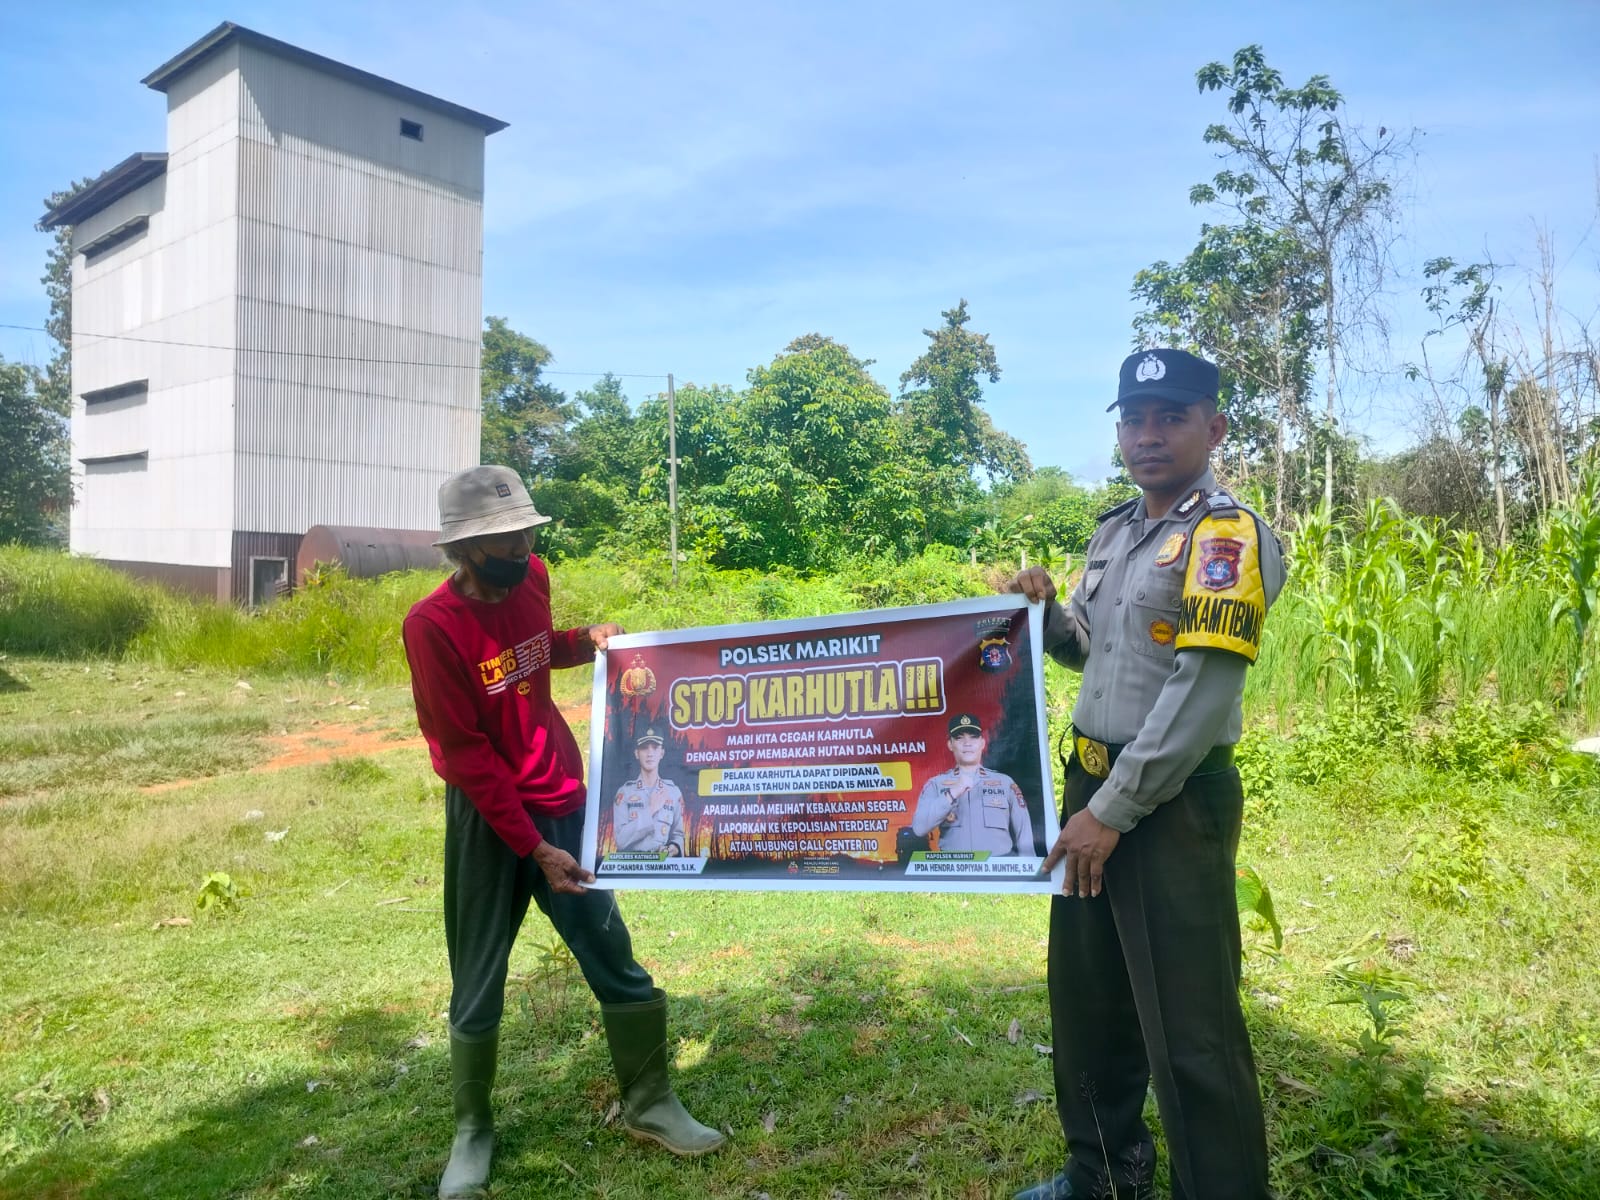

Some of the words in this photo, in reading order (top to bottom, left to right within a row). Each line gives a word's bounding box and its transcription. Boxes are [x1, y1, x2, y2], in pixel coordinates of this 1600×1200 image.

[721, 643, 792, 667] POLSEK
[796, 635, 881, 660] MARIKIT
[477, 648, 514, 672] TIMER
[673, 679, 743, 725] STOP
[749, 667, 899, 719] KARHUTLA
[904, 663, 940, 710] !!!
[726, 734, 753, 748] MARI
[755, 732, 778, 746] KITA
[780, 730, 816, 744] CEGAH
[817, 727, 874, 742] KARHUTLA
[686, 751, 728, 763] DENGAN
[728, 749, 755, 761] STOP
[756, 746, 816, 760] MEMBAKAR
[817, 744, 856, 757] HUTAN
[856, 743, 882, 755] DAN
[884, 741, 926, 755] LAHAN
[723, 769, 755, 780] PELAKU
[756, 768, 801, 780] KARHUTLA
[802, 767, 832, 779] DAPAT
[833, 766, 880, 778] DIPIDANA
[712, 781, 751, 793] PENJARA
[752, 781, 761, 792] 15
[761, 780, 792, 792] TAHUN
[792, 780, 812, 791] DAN
[813, 778, 845, 791] DENDA
[845, 779, 856, 789] 15
[856, 777, 894, 790] MILYAR
[703, 804, 740, 816] APABILA
[740, 803, 766, 815] ANDA
[766, 802, 805, 815] MELIHAT
[806, 801, 866, 815] KEBAKARAN
[867, 800, 906, 813] SEGERA
[719, 822, 767, 834] LAPORKAN
[768, 822, 780, 833] KE
[781, 820, 840, 833] KEPOLISIAN
[839, 819, 889, 832] TERDEKAT
[729, 840, 753, 852] ATAU
[754, 840, 799, 852] HUBUNGI
[799, 839, 824, 852] CALL
[824, 839, 863, 851] CENTER
[863, 839, 878, 851] 110
[617, 863, 643, 871] CHANDRA
[914, 864, 929, 872] IPDA
[929, 864, 955, 872] HENDRA
